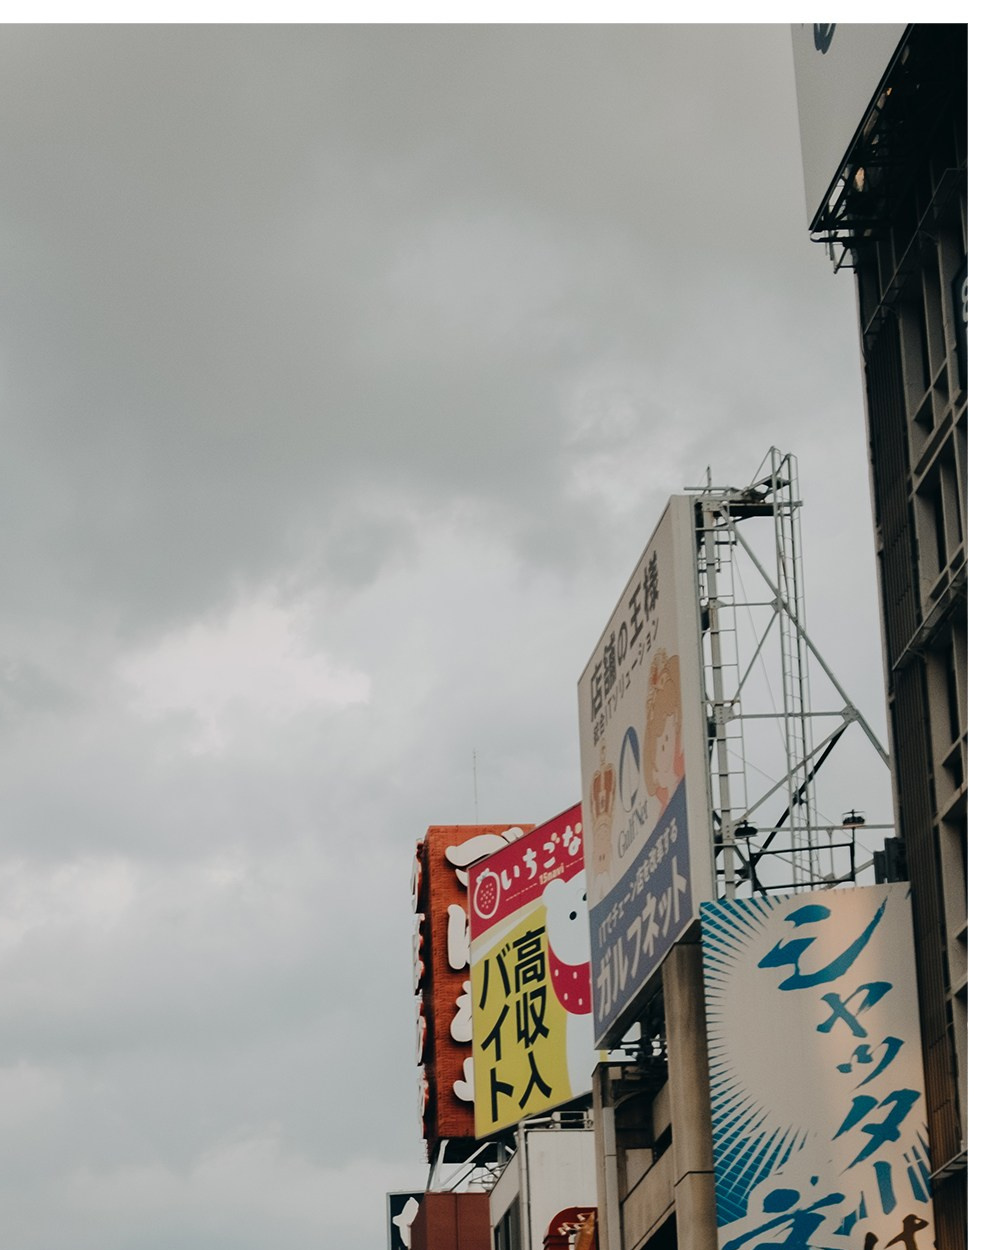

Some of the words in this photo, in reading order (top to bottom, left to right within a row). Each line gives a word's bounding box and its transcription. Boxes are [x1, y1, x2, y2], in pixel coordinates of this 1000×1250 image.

[590, 550, 660, 722] 店舗の王様
[596, 856, 688, 1023] ガルフネット
[478, 943, 515, 1123] バイト
